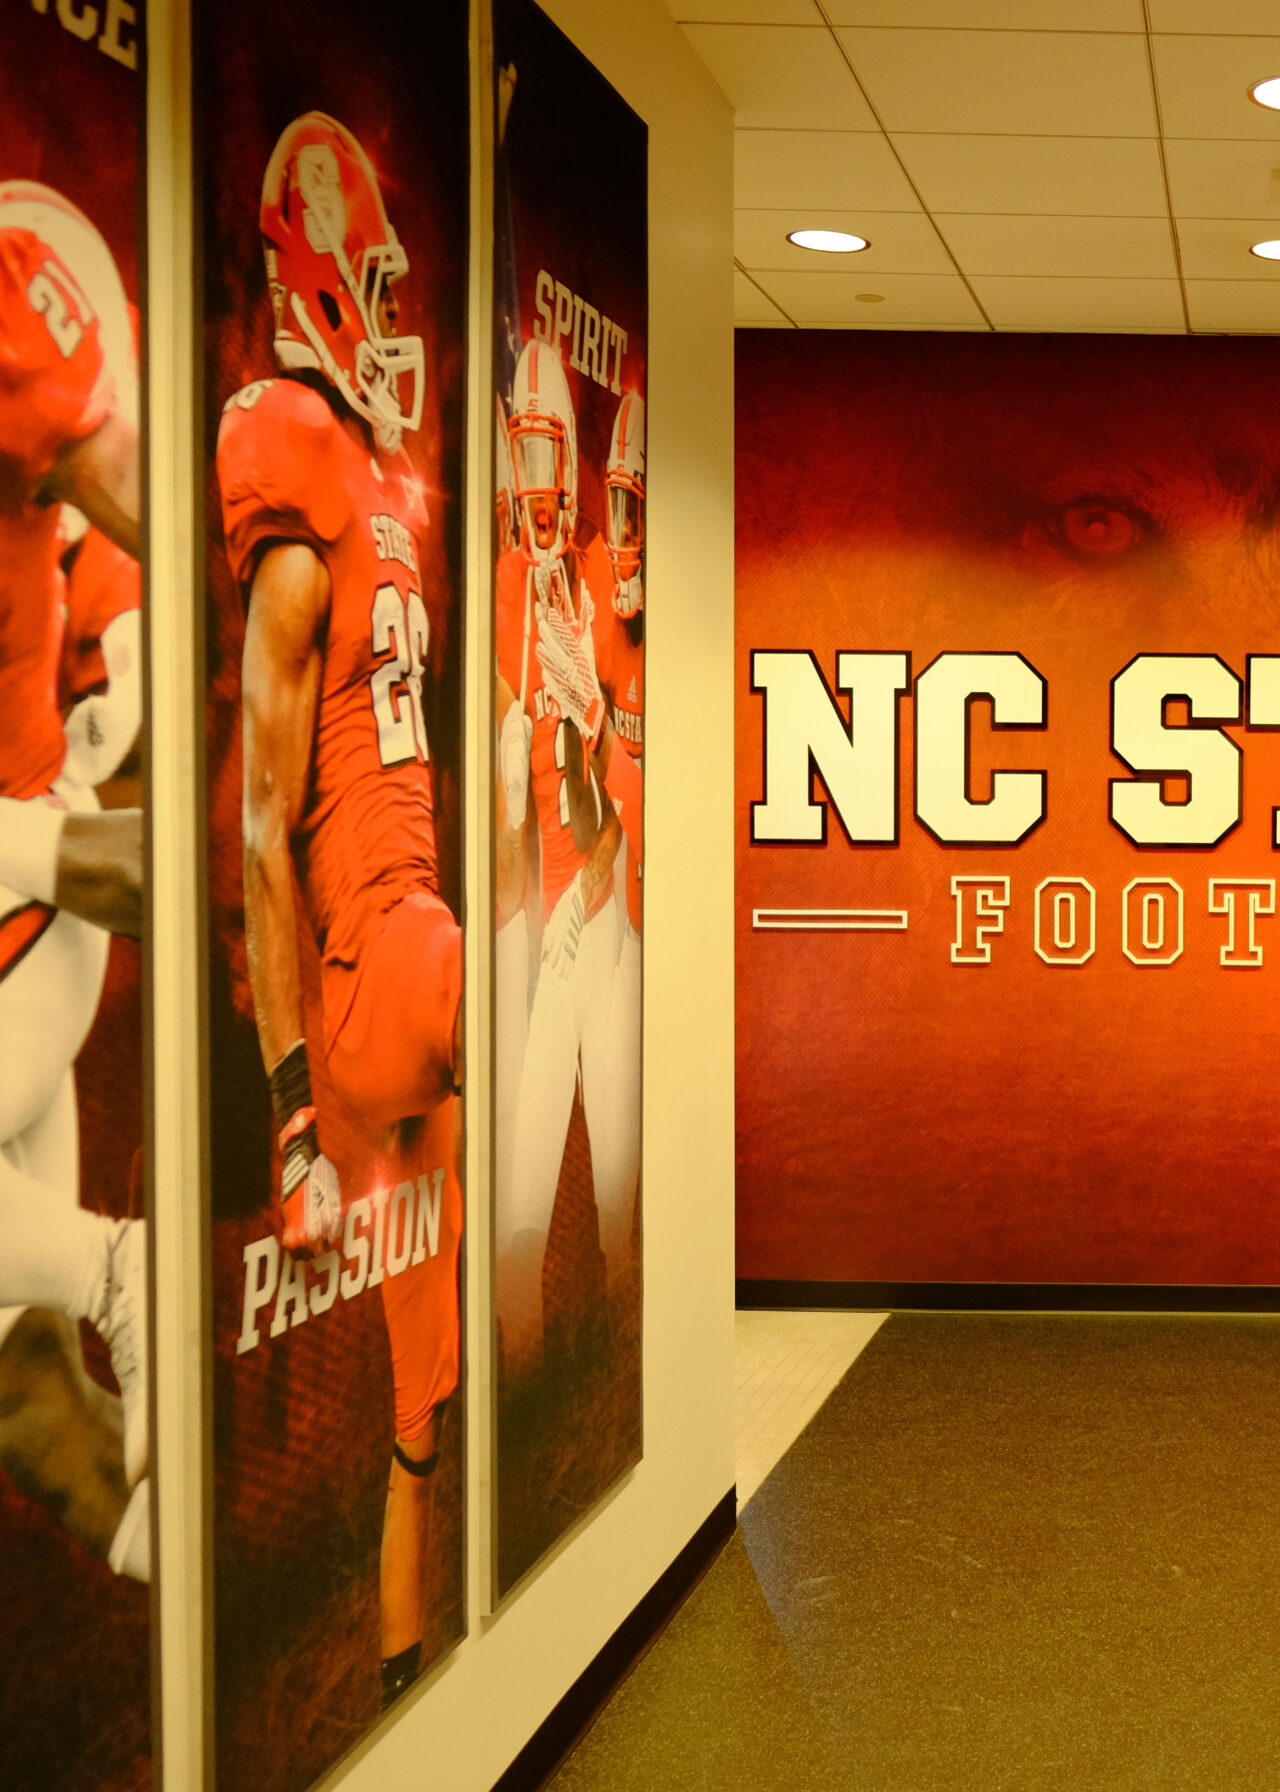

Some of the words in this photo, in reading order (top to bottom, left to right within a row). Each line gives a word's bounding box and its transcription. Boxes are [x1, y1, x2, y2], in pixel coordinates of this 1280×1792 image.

[533, 269, 628, 397] SPIRIT
[750, 649, 1047, 848] NC
[236, 1166, 446, 1356] PASSION
